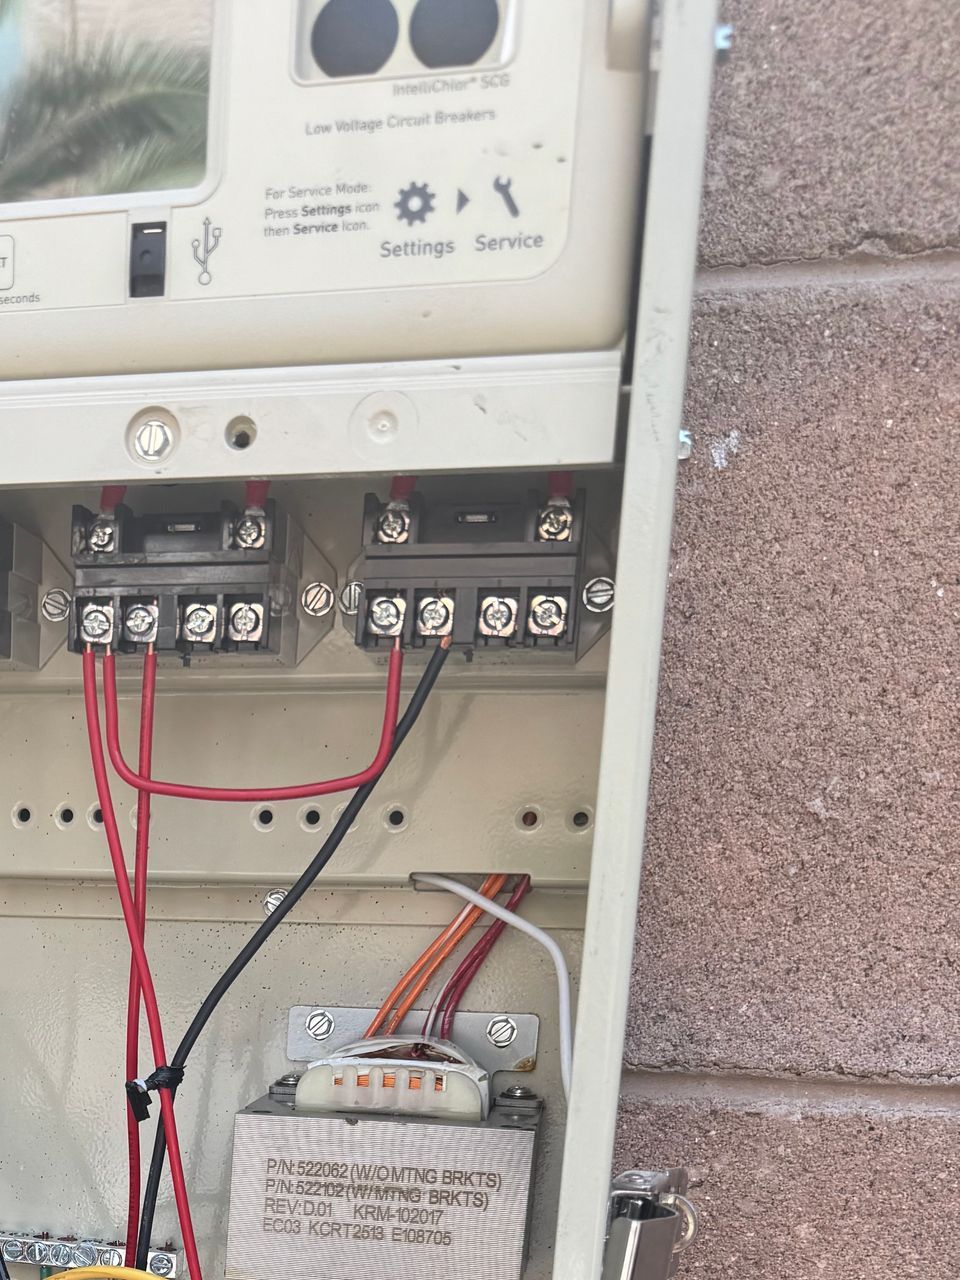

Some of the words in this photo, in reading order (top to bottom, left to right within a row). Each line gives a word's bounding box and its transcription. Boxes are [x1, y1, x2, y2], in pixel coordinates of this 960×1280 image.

[305, 121, 332, 136] Low
[336, 117, 383, 134] Voltage
[386, 113, 431, 129] Circuit
[435, 109, 497, 124] Breakers
[265, 188, 285, 200] For
[289, 185, 332, 199] Service
[336, 183, 372, 195] Mode:
[264, 208, 298, 220] Press
[301, 203, 352, 218] Settings
[355, 202, 380, 213] icon
[264, 225, 290, 238] then
[293, 222, 339, 235] Service
[380, 239, 456, 258] Settings
[475, 232, 544, 251] Service
[442, 1170, 502, 1192] BRKTS)
[429, 1190, 488, 1212] BRKTS)
[353, 1203, 444, 1225] KRM-102017
[263, 1217, 301, 1234] EC03
[392, 1227, 451, 1246] E108705
